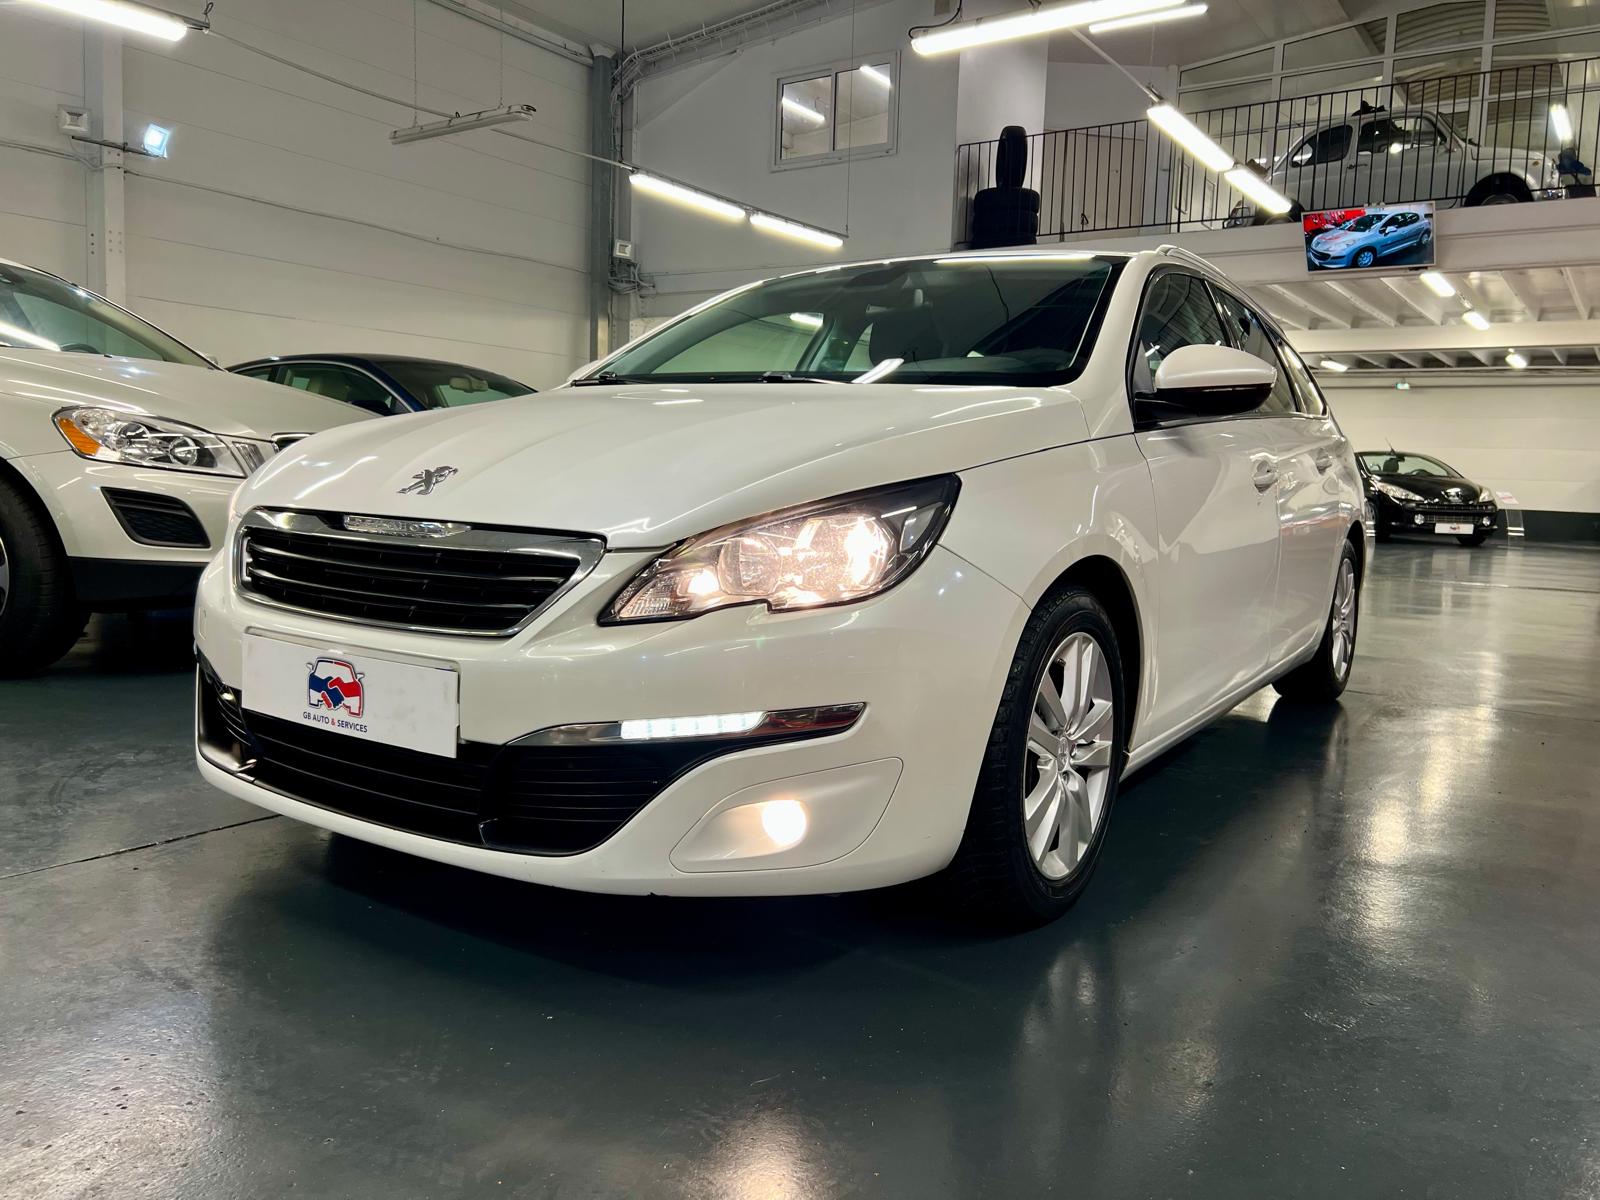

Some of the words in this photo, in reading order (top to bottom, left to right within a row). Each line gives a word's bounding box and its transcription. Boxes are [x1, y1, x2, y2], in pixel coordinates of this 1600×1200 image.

[303, 711, 311, 719] GB
[313, 714, 329, 724] AUTO
[331, 718, 335, 726] &
[337, 719, 368, 733] SERVICES
